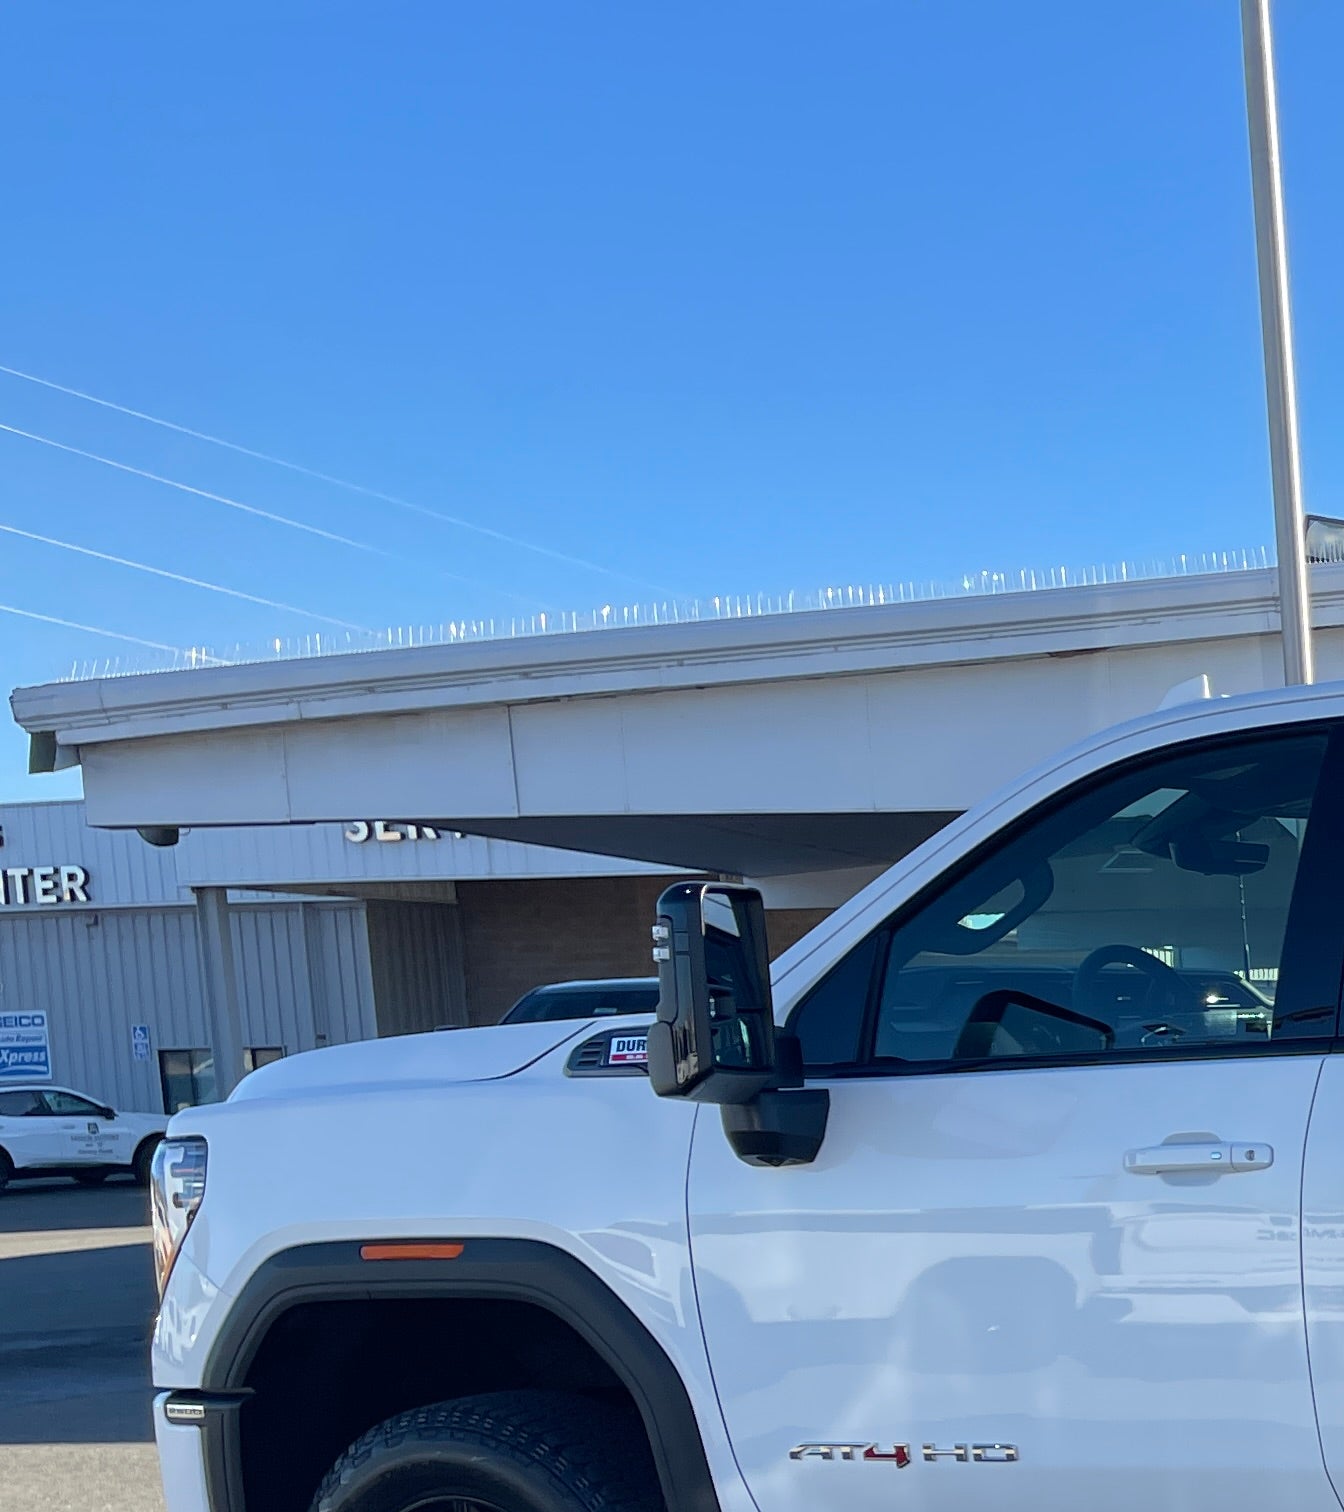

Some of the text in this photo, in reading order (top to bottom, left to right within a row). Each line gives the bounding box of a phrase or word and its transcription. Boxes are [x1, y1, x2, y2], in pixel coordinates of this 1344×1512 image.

[0, 864, 91, 905] TER
[0, 1015, 45, 1028] EICO
[789, 1442, 1019, 1468] AT4 HD
